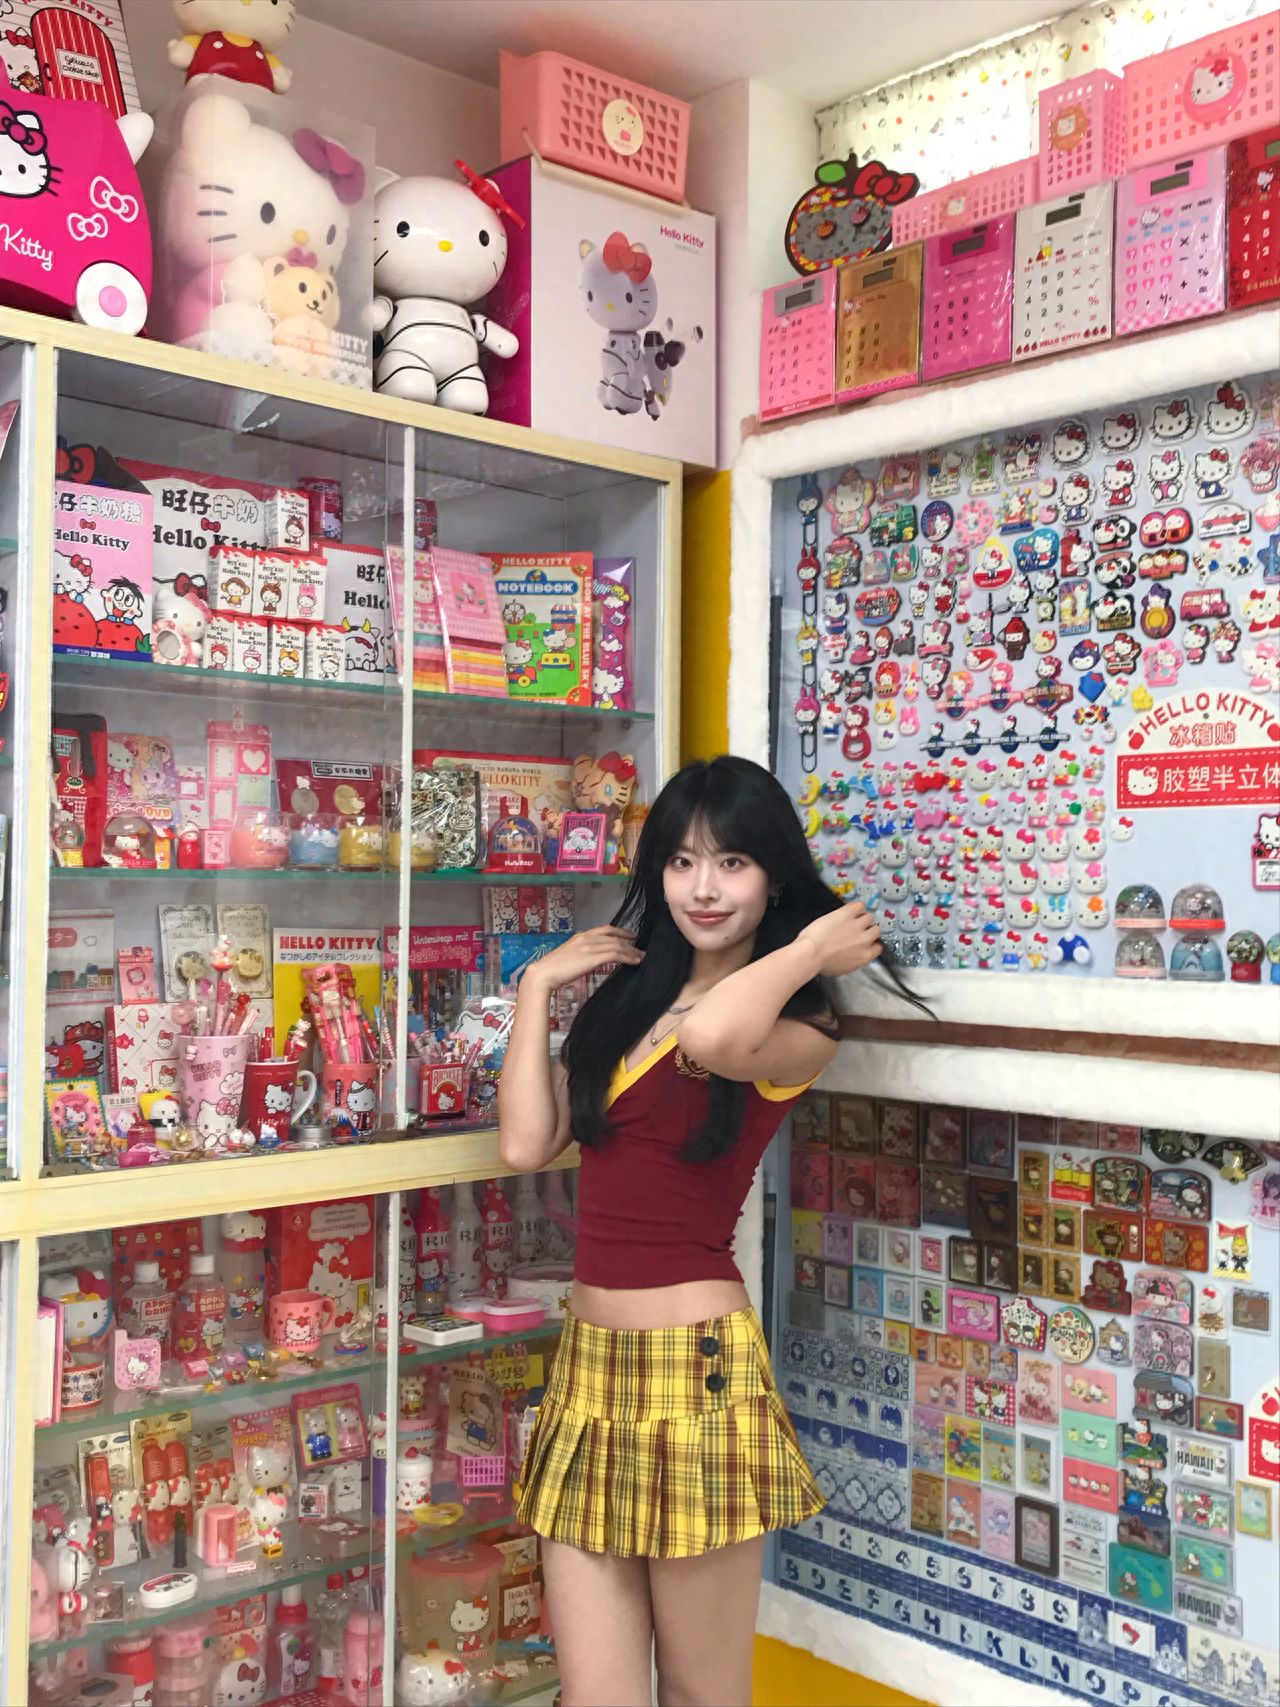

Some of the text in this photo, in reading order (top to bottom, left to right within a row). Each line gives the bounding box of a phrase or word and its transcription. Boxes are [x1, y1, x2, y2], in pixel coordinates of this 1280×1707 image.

[1243, 215, 1250, 225] 7
[660, 226, 681, 243] Hello
[682, 230, 704, 249] Kitty
[1243, 233, 1250, 243] 4
[1, 225, 53, 271] Kitty
[1243, 246, 1270, 261] 1 2
[1026, 271, 1064, 289] 7 8 9
[1242, 269, 1250, 279] 0
[1025, 287, 1064, 304] 4 5 6
[934, 304, 940, 313] 7
[1041, 308, 1047, 317] 2
[1057, 304, 1063, 313] 3
[1024, 328, 1031, 338] 0
[1040, 336, 1059, 347] HELLO
[769, 352, 774, 361] 7
[793, 344, 799, 354] 9
[933, 352, 939, 360] 0
[769, 381, 774, 391] 1
[780, 378, 786, 387] 2
[845, 375, 851, 384] 0
[55, 491, 142, 523] 仔牛奶糖
[92, 534, 130, 551] Kitty
[502, 557, 572, 566] HELLO KITTY
[498, 582, 574, 594] NOTEBOOK
[344, 590, 390, 610] Hello
[583, 624, 591, 639] THE
[582, 643, 590, 665] BLUE
[581, 671, 589, 688] SKY
[1140, 692, 1275, 736] HELLO KITTY
[1169, 721, 1237, 748] 冰箱贴
[511, 775, 541, 787] KITTY
[1162, 762, 1280, 793] 胶塑半立体
[279, 936, 376, 950] HELLO KITTY
[413, 931, 469, 947] Unterwegs mit
[191, 1060, 221, 1074] HELLO
[1177, 1450, 1214, 1472] HAWAII
[814, 1521, 824, 1539] 1
[840, 1528, 852, 1550] 2
[867, 1537, 882, 1558] 3
[926, 1556, 942, 1578] 5
[989, 1576, 1004, 1599] 7
[1019, 1588, 1035, 1612] 8
[1053, 1599, 1070, 1623] 9
[1178, 1592, 1222, 1619] HAWAII
[839, 1578, 853, 1601] E
[894, 1600, 911, 1624] G
[924, 1609, 940, 1635] H
[1052, 1655, 1070, 1684] N
